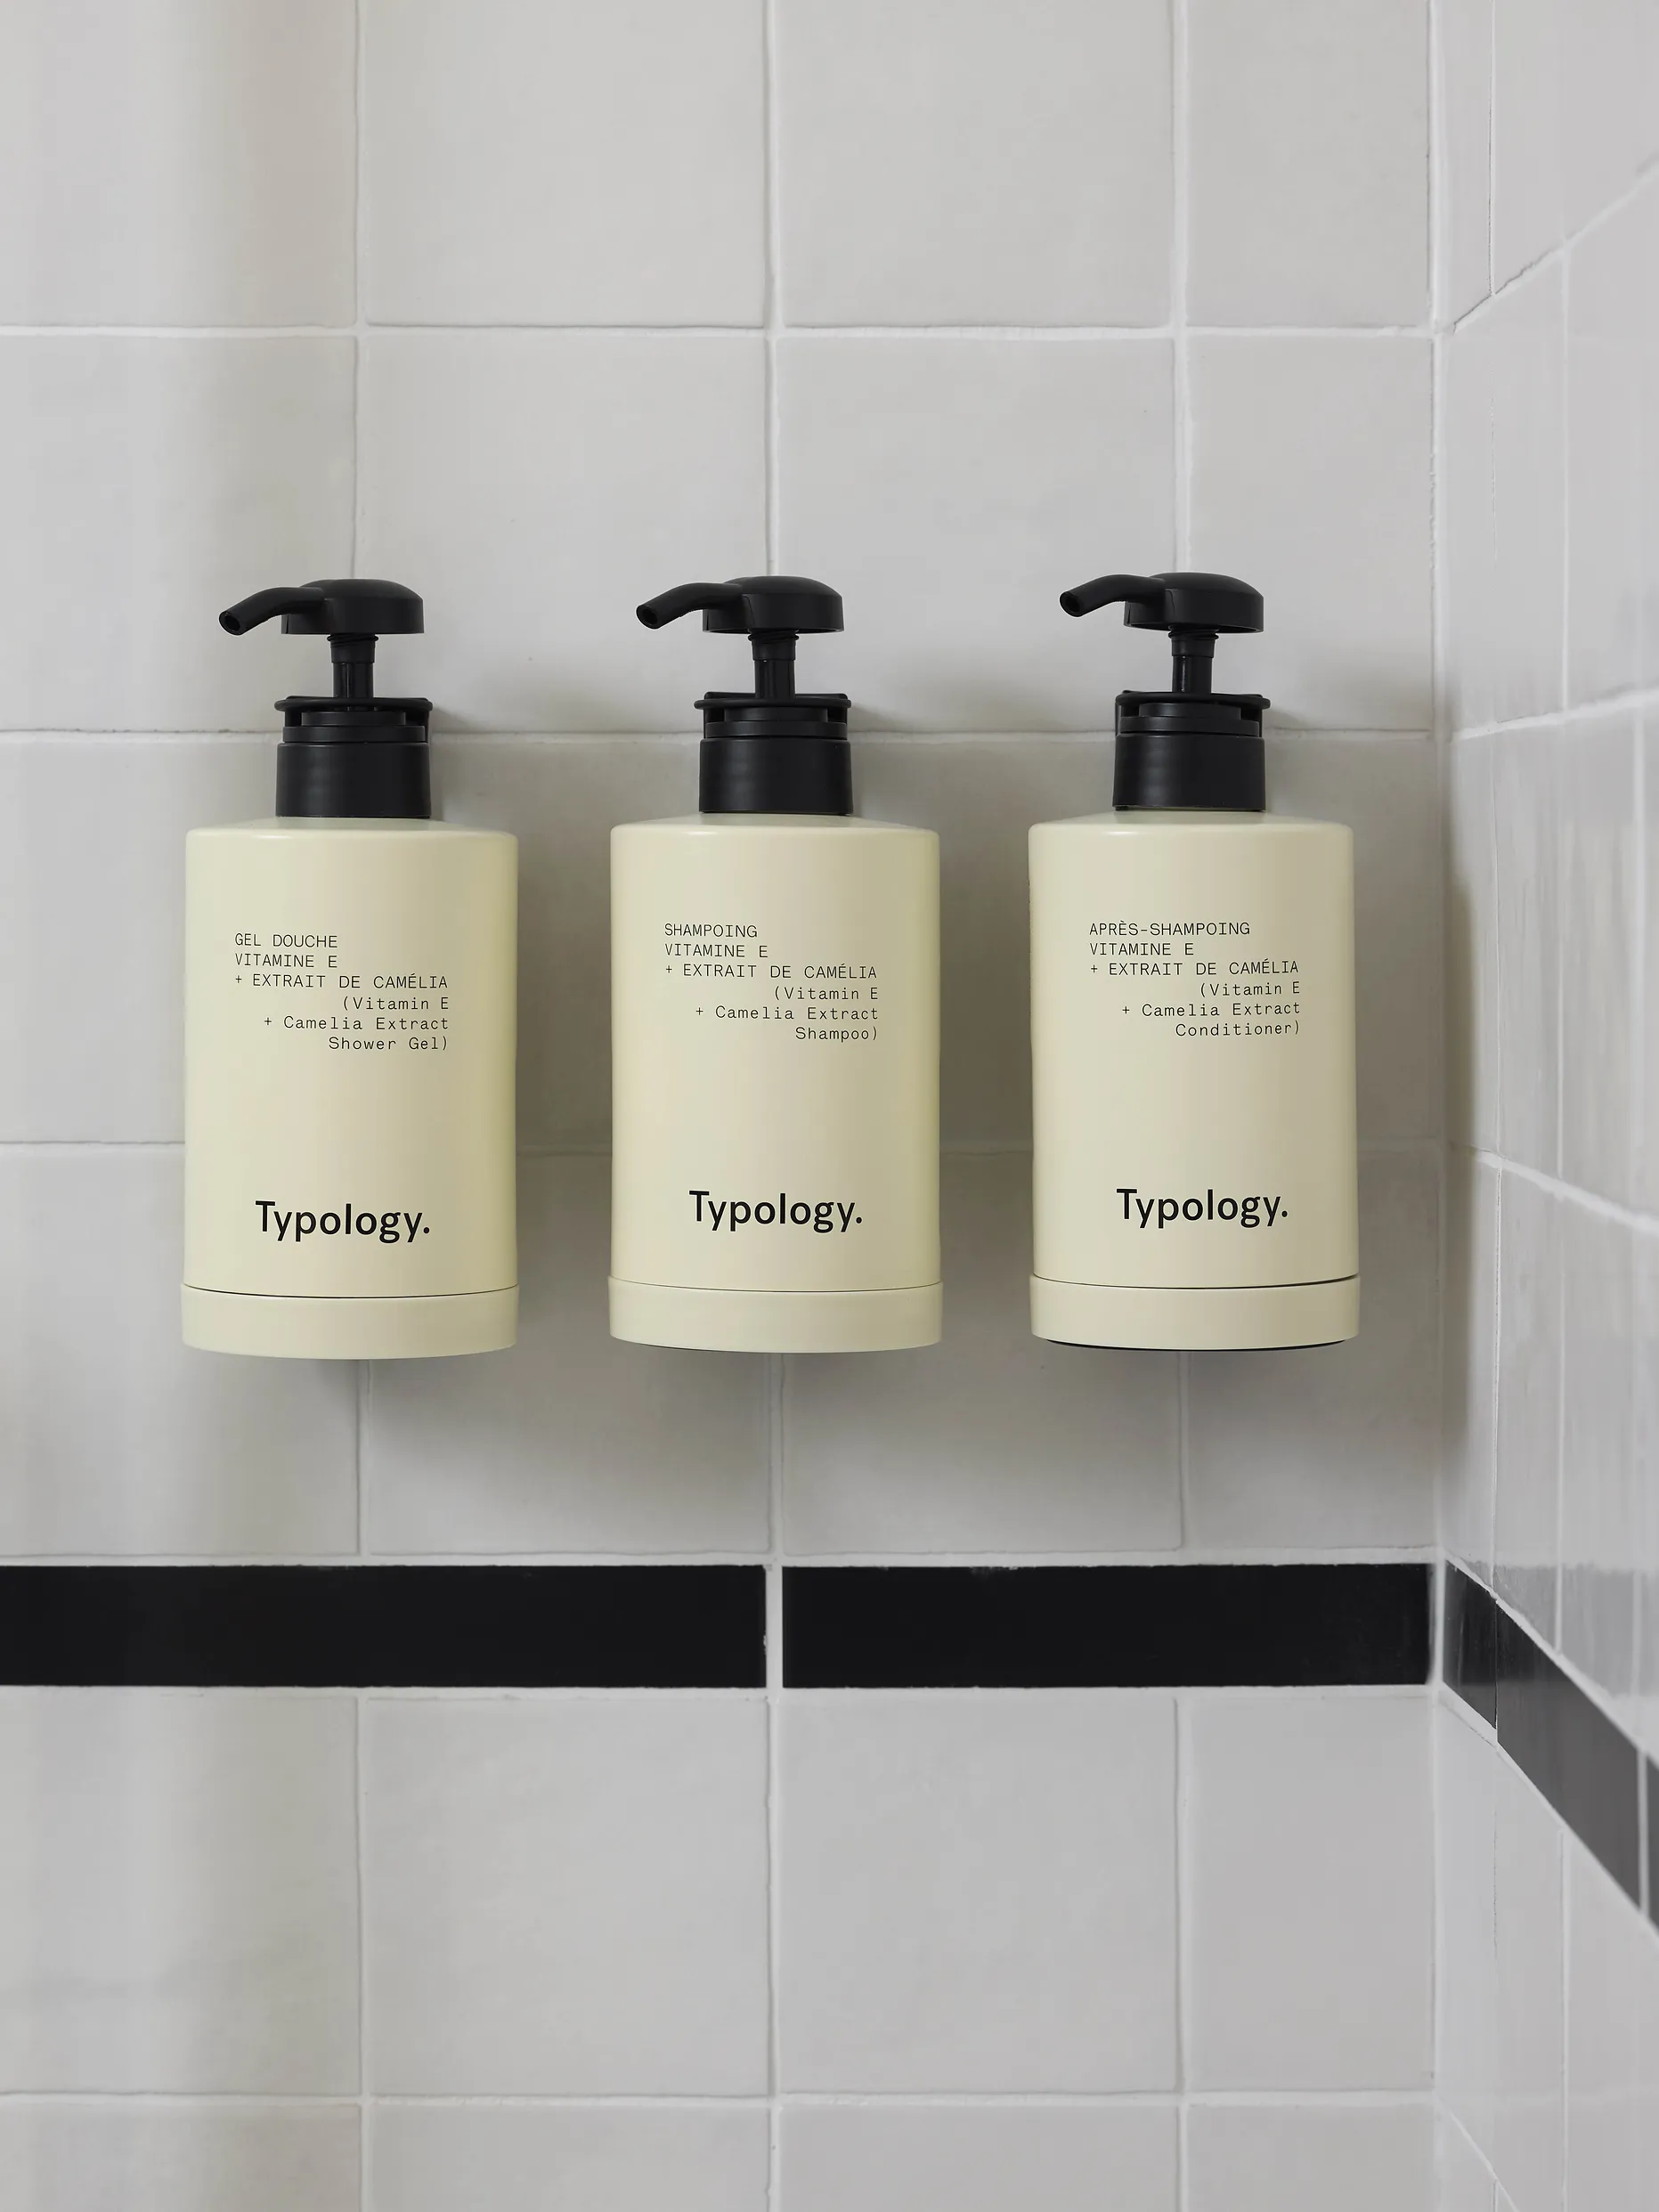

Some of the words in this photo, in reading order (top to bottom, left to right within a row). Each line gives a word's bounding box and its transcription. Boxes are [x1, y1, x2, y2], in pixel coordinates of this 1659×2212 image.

[664, 923, 758, 939] SHAMPOING
[1089, 920, 1250, 936] APRÈS-SHAMPOING
[234, 932, 262, 947] GEL
[272, 933, 338, 948] DOUCHE
[664, 943, 745, 958] VITAMINE
[759, 945, 769, 958] E
[1089, 942, 1172, 956] VITAMINE
[1184, 942, 1194, 956] E
[234, 953, 315, 968] VITAMINE
[328, 955, 337, 969] E
[1090, 964, 1098, 973] +
[1109, 962, 1183, 976] EXTRAIT
[1196, 962, 1217, 976] DE
[1229, 957, 1299, 975] CAMÉLIA
[665, 964, 673, 974] +
[683, 963, 757, 978] EXTRAIT
[770, 964, 792, 979] DE
[803, 963, 877, 980] CAMÉLIA
[235, 974, 242, 984] +
[252, 973, 326, 988] EXTRAIT
[338, 975, 361, 988] DE
[373, 972, 448, 989] CAMÉLIA
[1200, 981, 1282, 998] (Vitamin
[1292, 980, 1300, 995] E
[775, 985, 859, 1001] (Vitamin
[870, 987, 879, 1000] E
[343, 996, 429, 1012] (Vitamin
[441, 996, 449, 1010] E
[695, 1006, 704, 1016] +
[715, 1004, 795, 1020] Camelia
[807, 1006, 878, 1021] Extract
[1121, 1005, 1130, 1015] +
[1142, 1003, 1221, 1017] Camelia
[1232, 1001, 1300, 1016] Extract
[264, 1017, 272, 1027] +
[283, 1015, 363, 1030] Camelia
[376, 1016, 449, 1030] Extract
[1175, 1020, 1300, 1037] Conditioner)
[329, 1036, 396, 1051] Shower
[408, 1035, 448, 1052] Gel)
[795, 1026, 877, 1044] Shampoo)
[688, 1190, 863, 1234] Typology.
[1116, 1188, 1289, 1230] Typology.
[255, 1200, 430, 1244] Typology.
